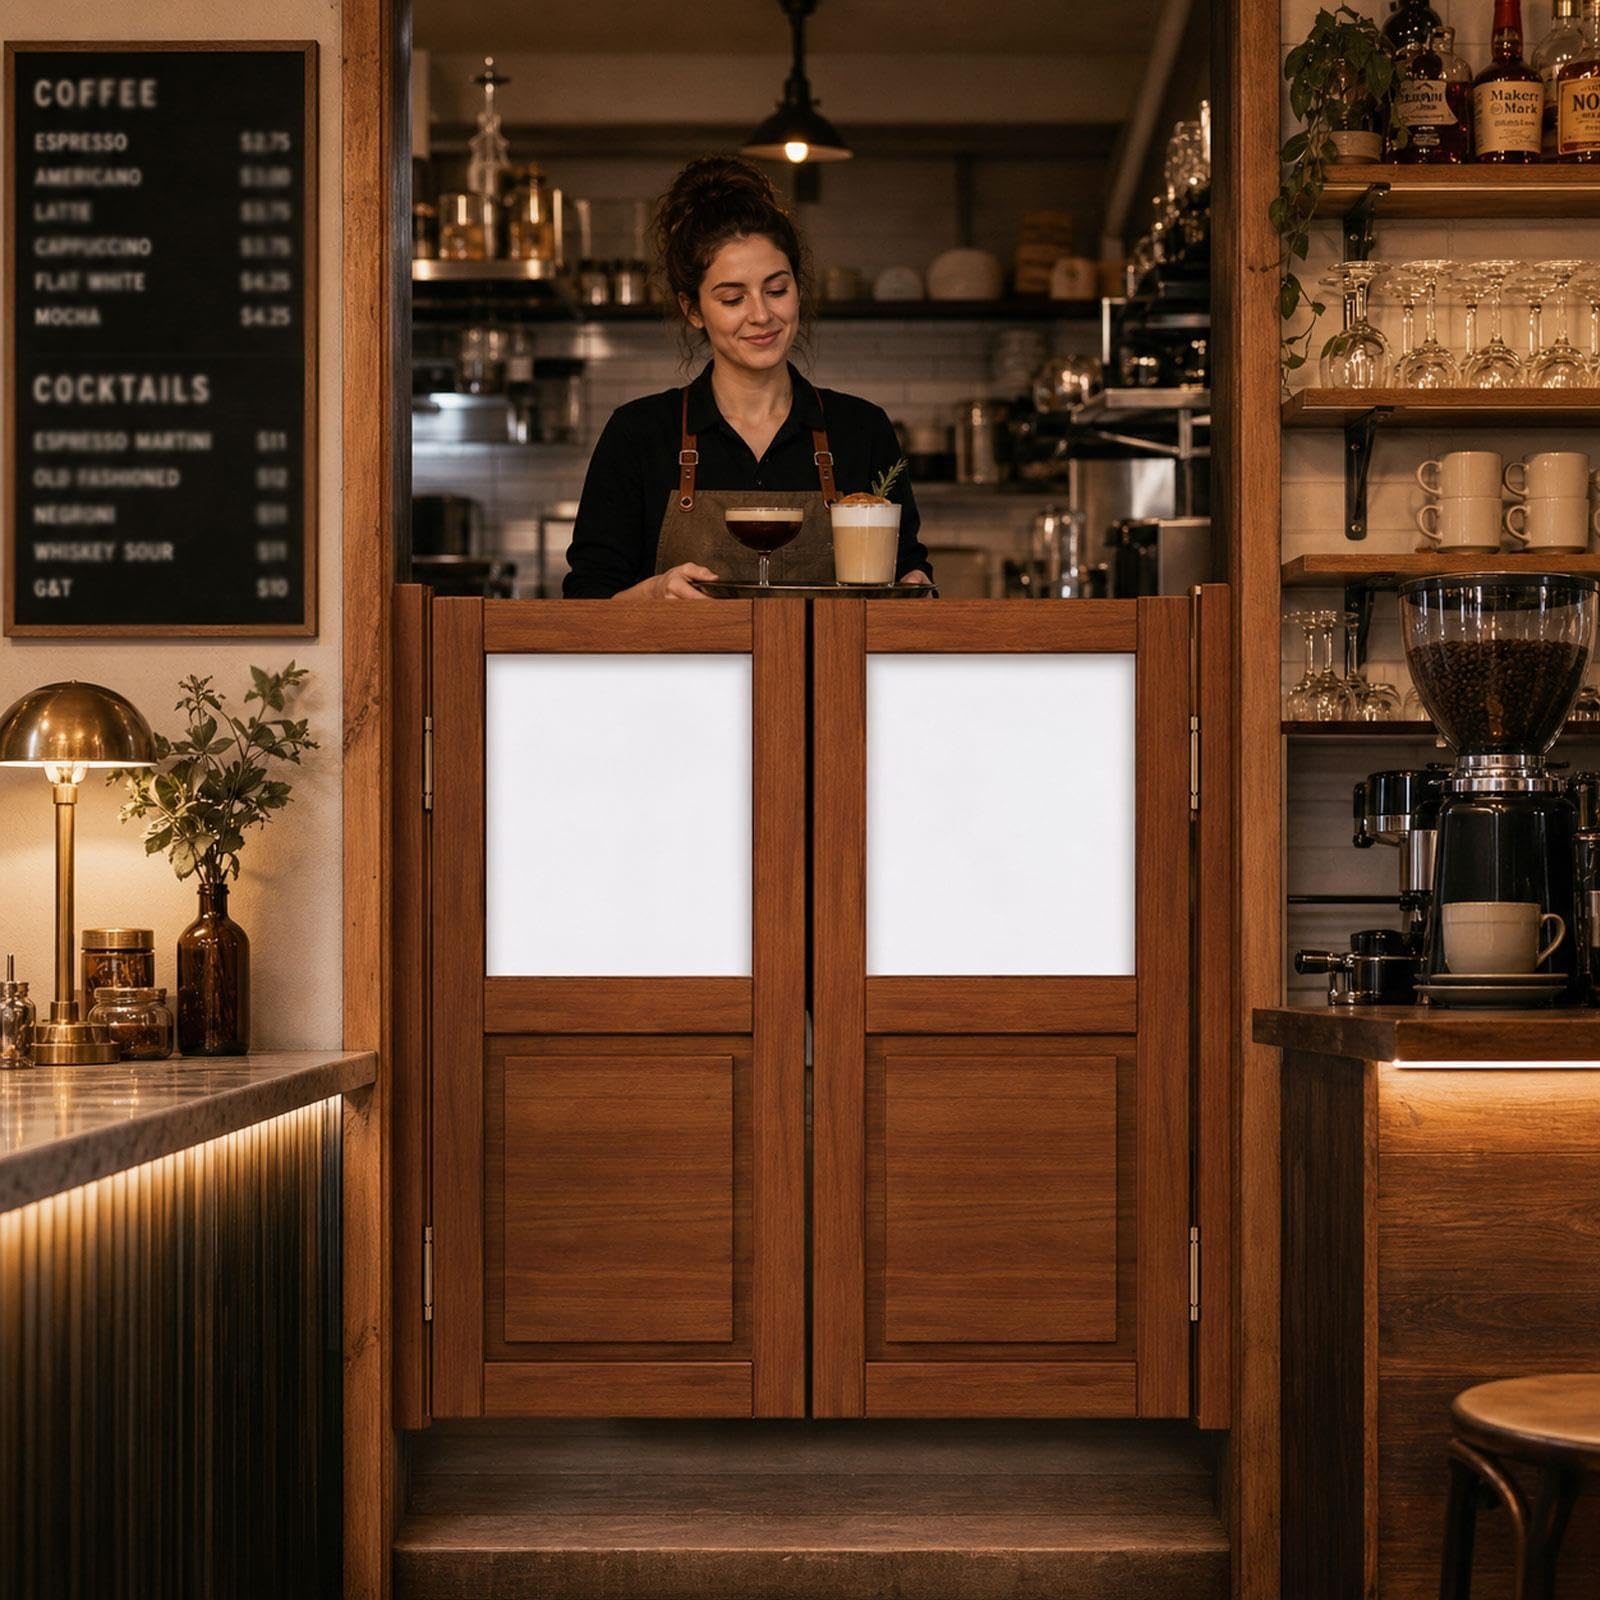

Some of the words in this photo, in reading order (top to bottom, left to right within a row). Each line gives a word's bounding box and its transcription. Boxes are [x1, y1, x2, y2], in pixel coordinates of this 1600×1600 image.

[34, 79, 156, 107] COFFEE
[35, 133, 127, 151] ESPRESSO
[35, 168, 142, 186] AMERICANO
[35, 203, 91, 221] LATTE
[35, 238, 151, 256] CAPPUCCINO
[35, 273, 79, 291] FLAT
[87, 273, 145, 291] WHITE
[35, 307, 101, 325] MOCHA
[33, 374, 210, 403] COCKTAILS
[34, 432, 128, 451] ESPRESSO
[135, 432, 212, 450] MARTINI
[33, 469, 70, 487] OLD
[77, 468, 180, 487] FASHIONED
[34, 505, 115, 524] NEGRONI
[34, 542, 115, 561] WHISKEY
[124, 542, 173, 561] SOUR
[34, 579, 73, 597] G&T
[257, 579, 288, 598] $10
